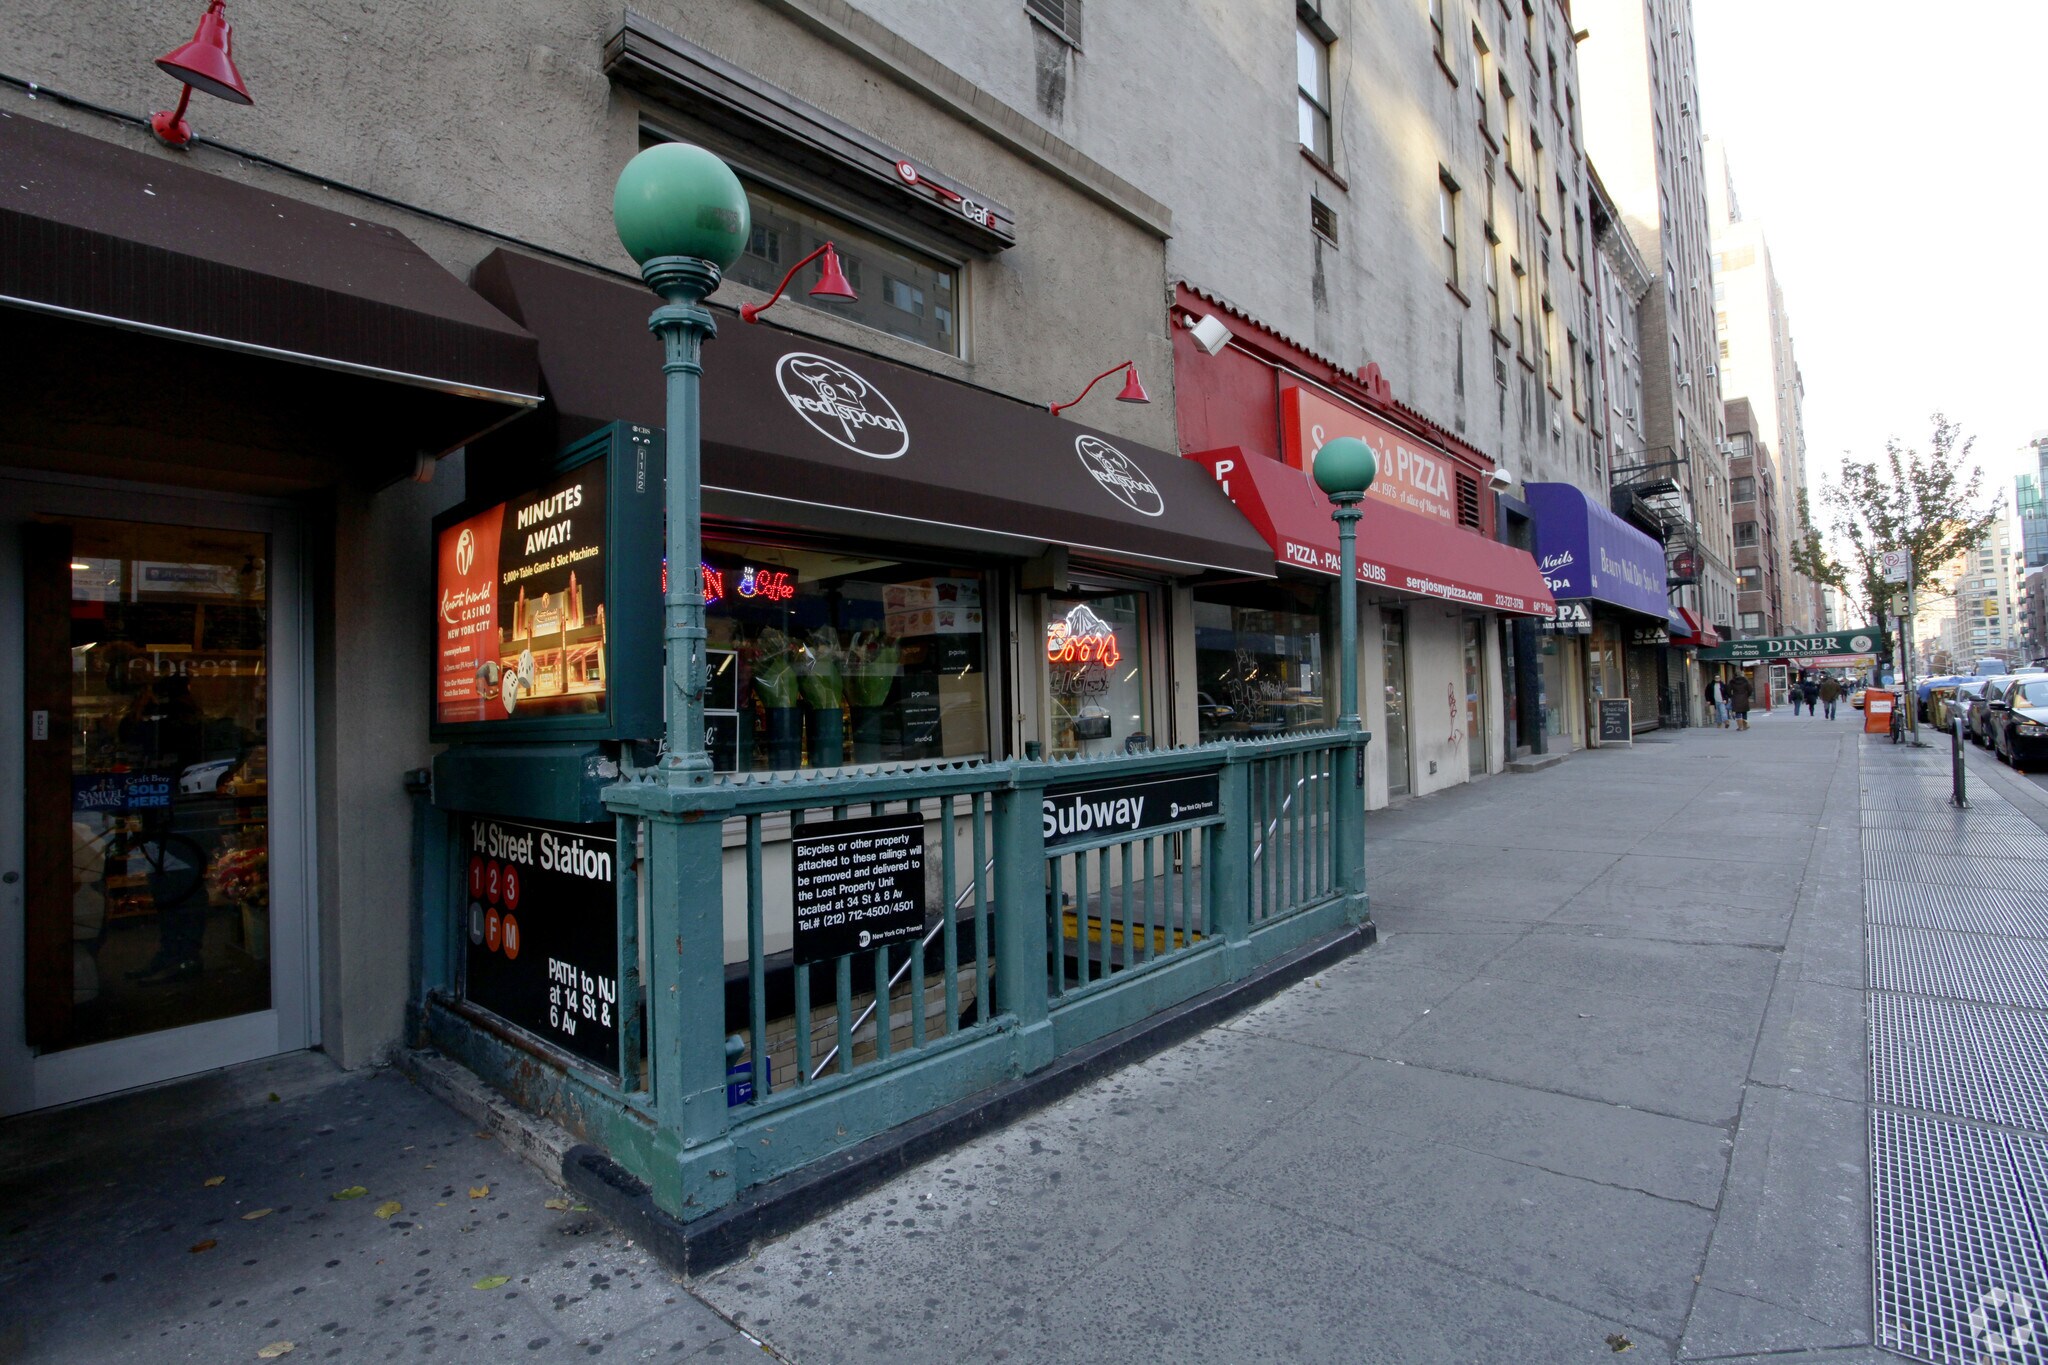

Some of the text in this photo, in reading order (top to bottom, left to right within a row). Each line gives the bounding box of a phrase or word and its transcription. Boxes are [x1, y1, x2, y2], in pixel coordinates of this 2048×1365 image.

[1396, 445, 1449, 500] PIZZA
[1382, 482, 1397, 499] 1975
[517, 484, 582, 530] MINUTES
[1406, 494, 1418, 508] slice
[1420, 498, 1426, 513] of
[1426, 499, 1438, 514] New
[1438, 504, 1451, 520] York
[525, 520, 571, 556] AWAY!
[503, 546, 599, 585] 5,000+ Table Game & Slot Machines
[1286, 542, 1318, 566] PIZZA
[1325, 552, 1341, 570] PAS
[1363, 562, 1386, 582] SUBS
[1406, 576, 1483, 603] sergiosnypizza.com
[1538, 550, 1574, 570] Nails
[756, 570, 794, 601] Coffee
[462, 604, 490, 620] CASINO
[448, 620, 490, 640] NEW YORK CITY
[1634, 627, 1667, 640] SPA
[1048, 622, 1120, 667] Coors
[1766, 637, 1842, 653] DINER
[126, 774, 170, 786] Craft Beer
[128, 784, 169, 794] SOLD
[78, 788, 126, 800] SAMUEL
[81, 798, 122, 808] ADAMS
[128, 796, 170, 807] HERE
[1043, 796, 1144, 838] Subway
[471, 820, 612, 882] 14 Street Station
[798, 834, 910, 858] Bicycles or other property
[798, 845, 922, 872] attached to these railings will
[473, 866, 516, 900] 1 2 3
[798, 860, 920, 886] be removed and delivered to
[798, 876, 894, 902] the Lost Property Unit
[798, 889, 902, 917] located at 34 St & 8 Av
[798, 900, 914, 932] Tel.# (212) 712-4500/4501
[473, 914, 516, 950] L F M
[884, 930, 896, 938] York
[896, 927, 906, 936] City
[906, 924, 923, 934] Transit
[548, 958, 616, 1004] PATH to NJ
[550, 986, 612, 1028] at 14 St &
[550, 1005, 576, 1038] 6 Av
